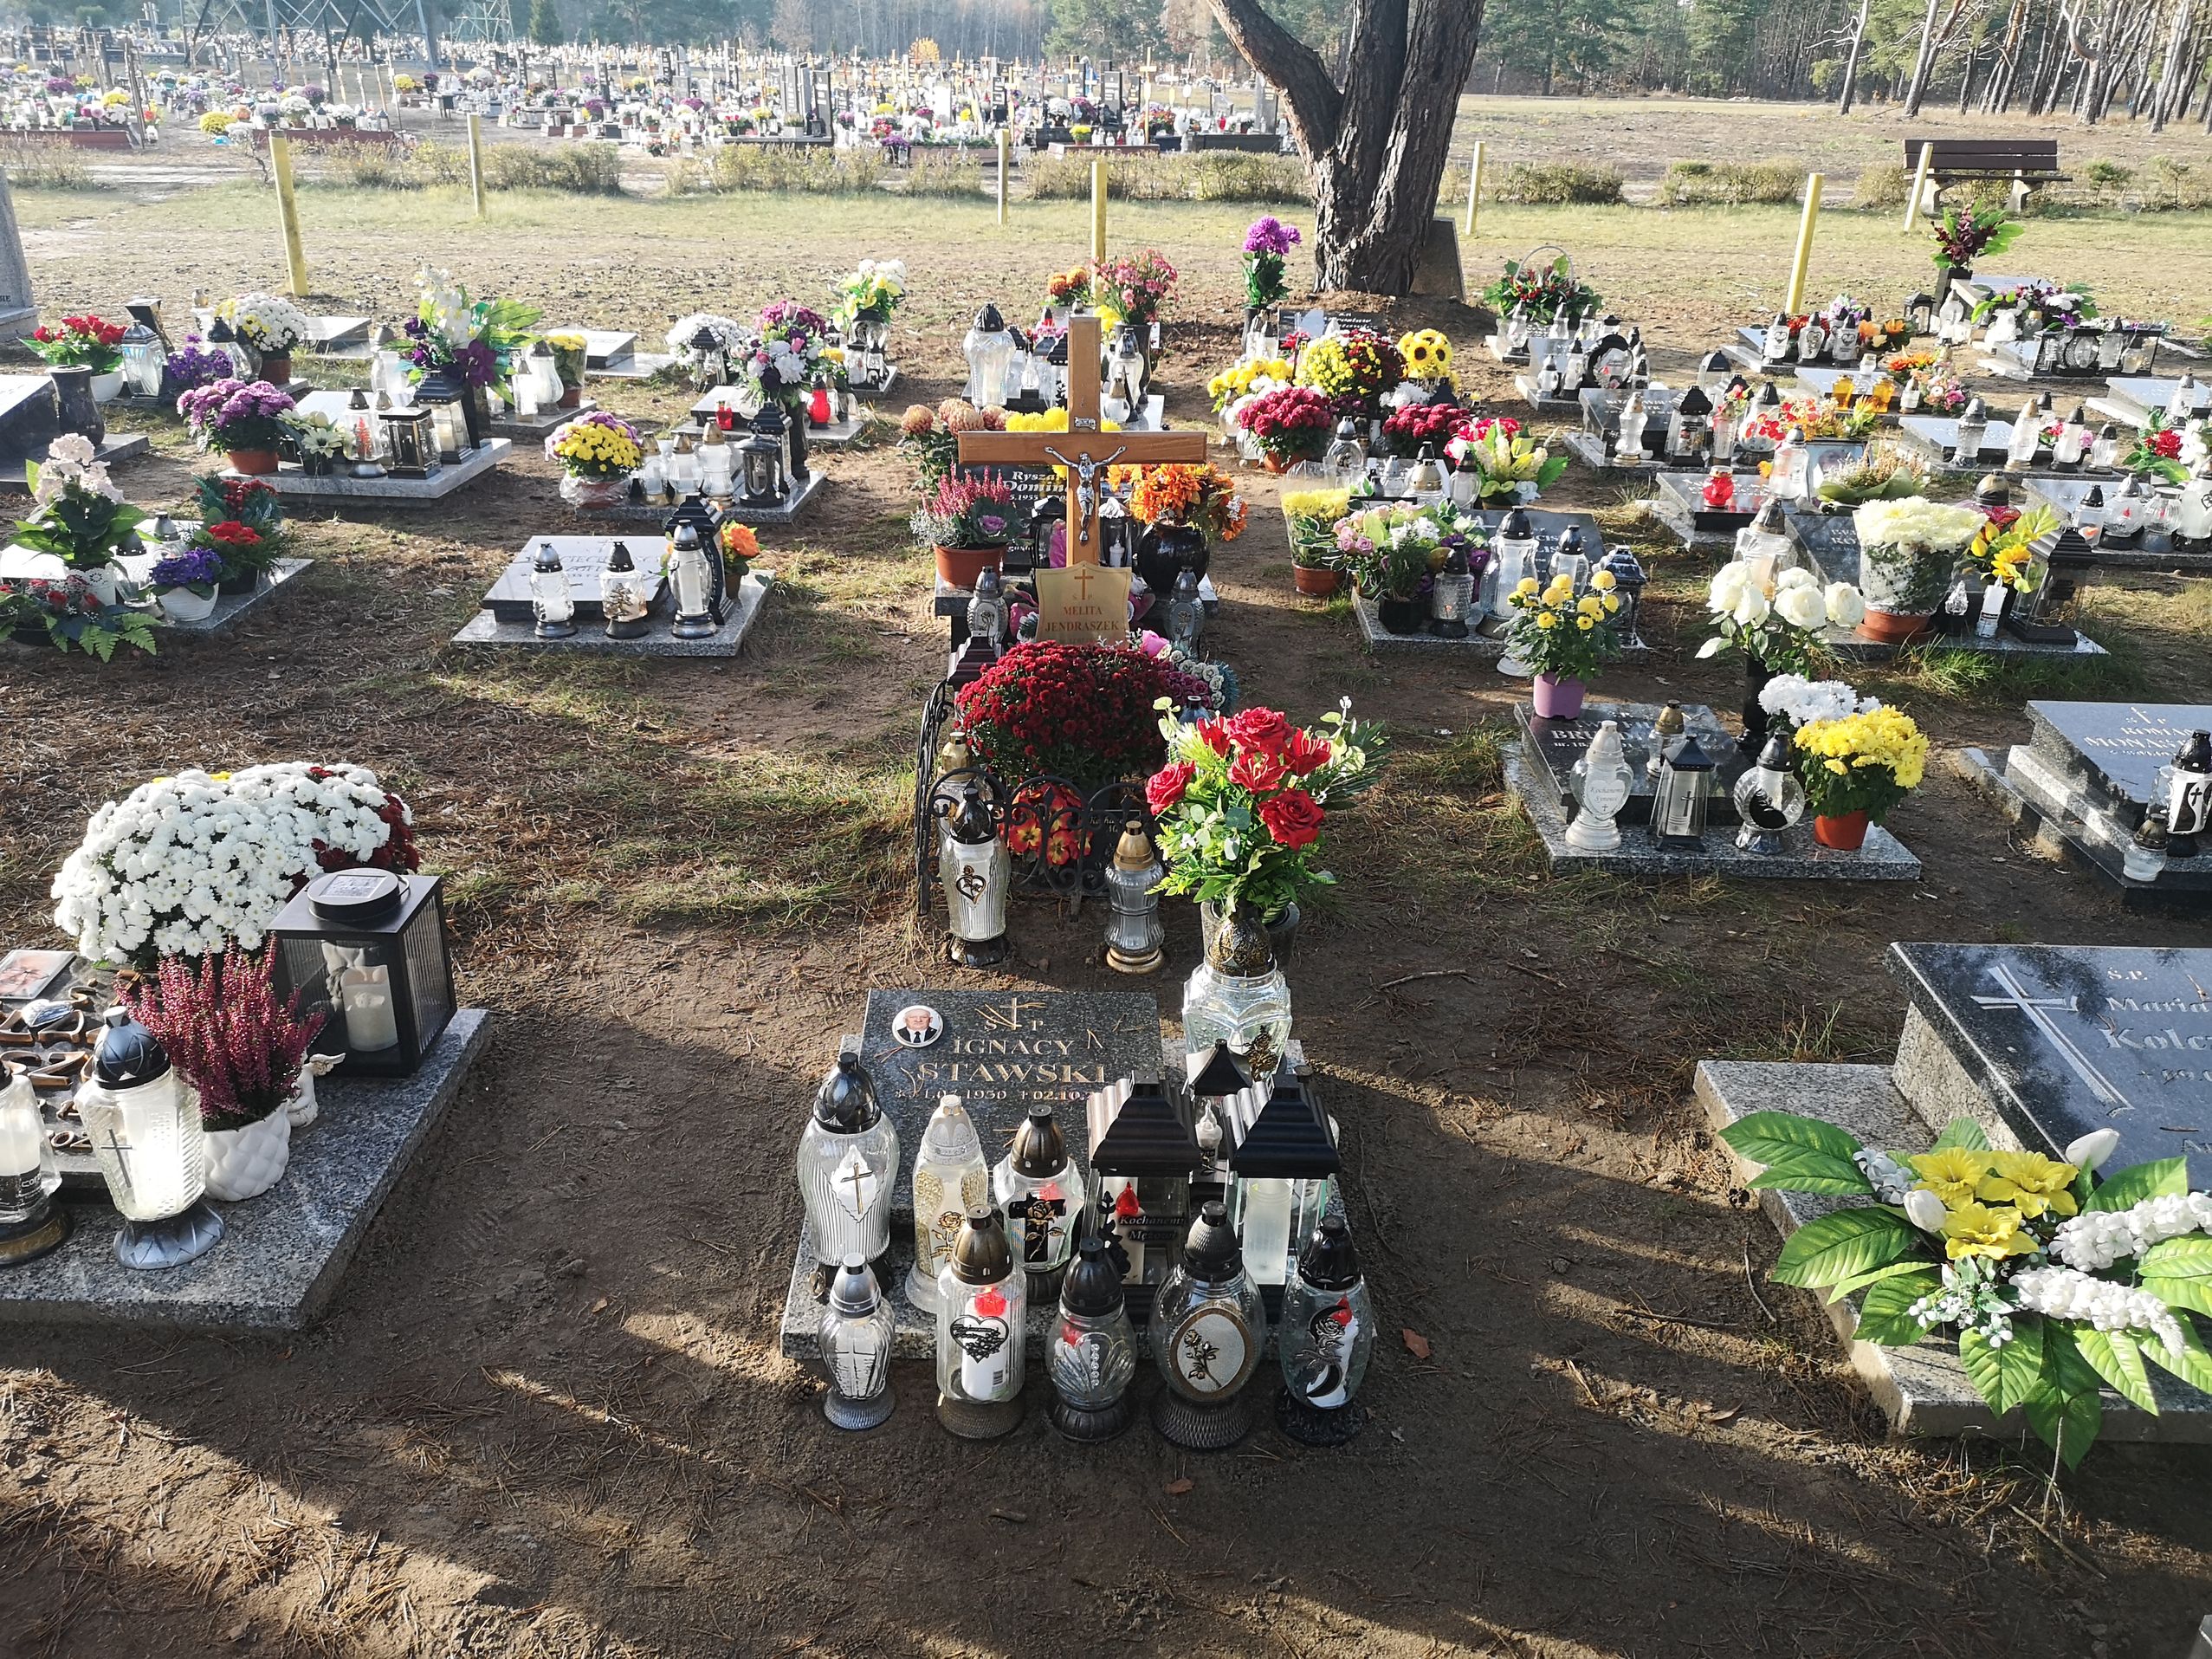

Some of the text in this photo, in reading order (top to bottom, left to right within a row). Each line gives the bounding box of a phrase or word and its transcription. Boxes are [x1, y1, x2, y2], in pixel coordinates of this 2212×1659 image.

[1003, 480, 1068, 492] Domin
[1064, 606, 1103, 615] MELITA
[1045, 620, 1119, 632] JENDRASZEK
[2105, 997, 2210, 1012] Maria
[954, 1036, 1073, 1055] IGNACY
[916, 1062, 1105, 1083] STAWSKI
